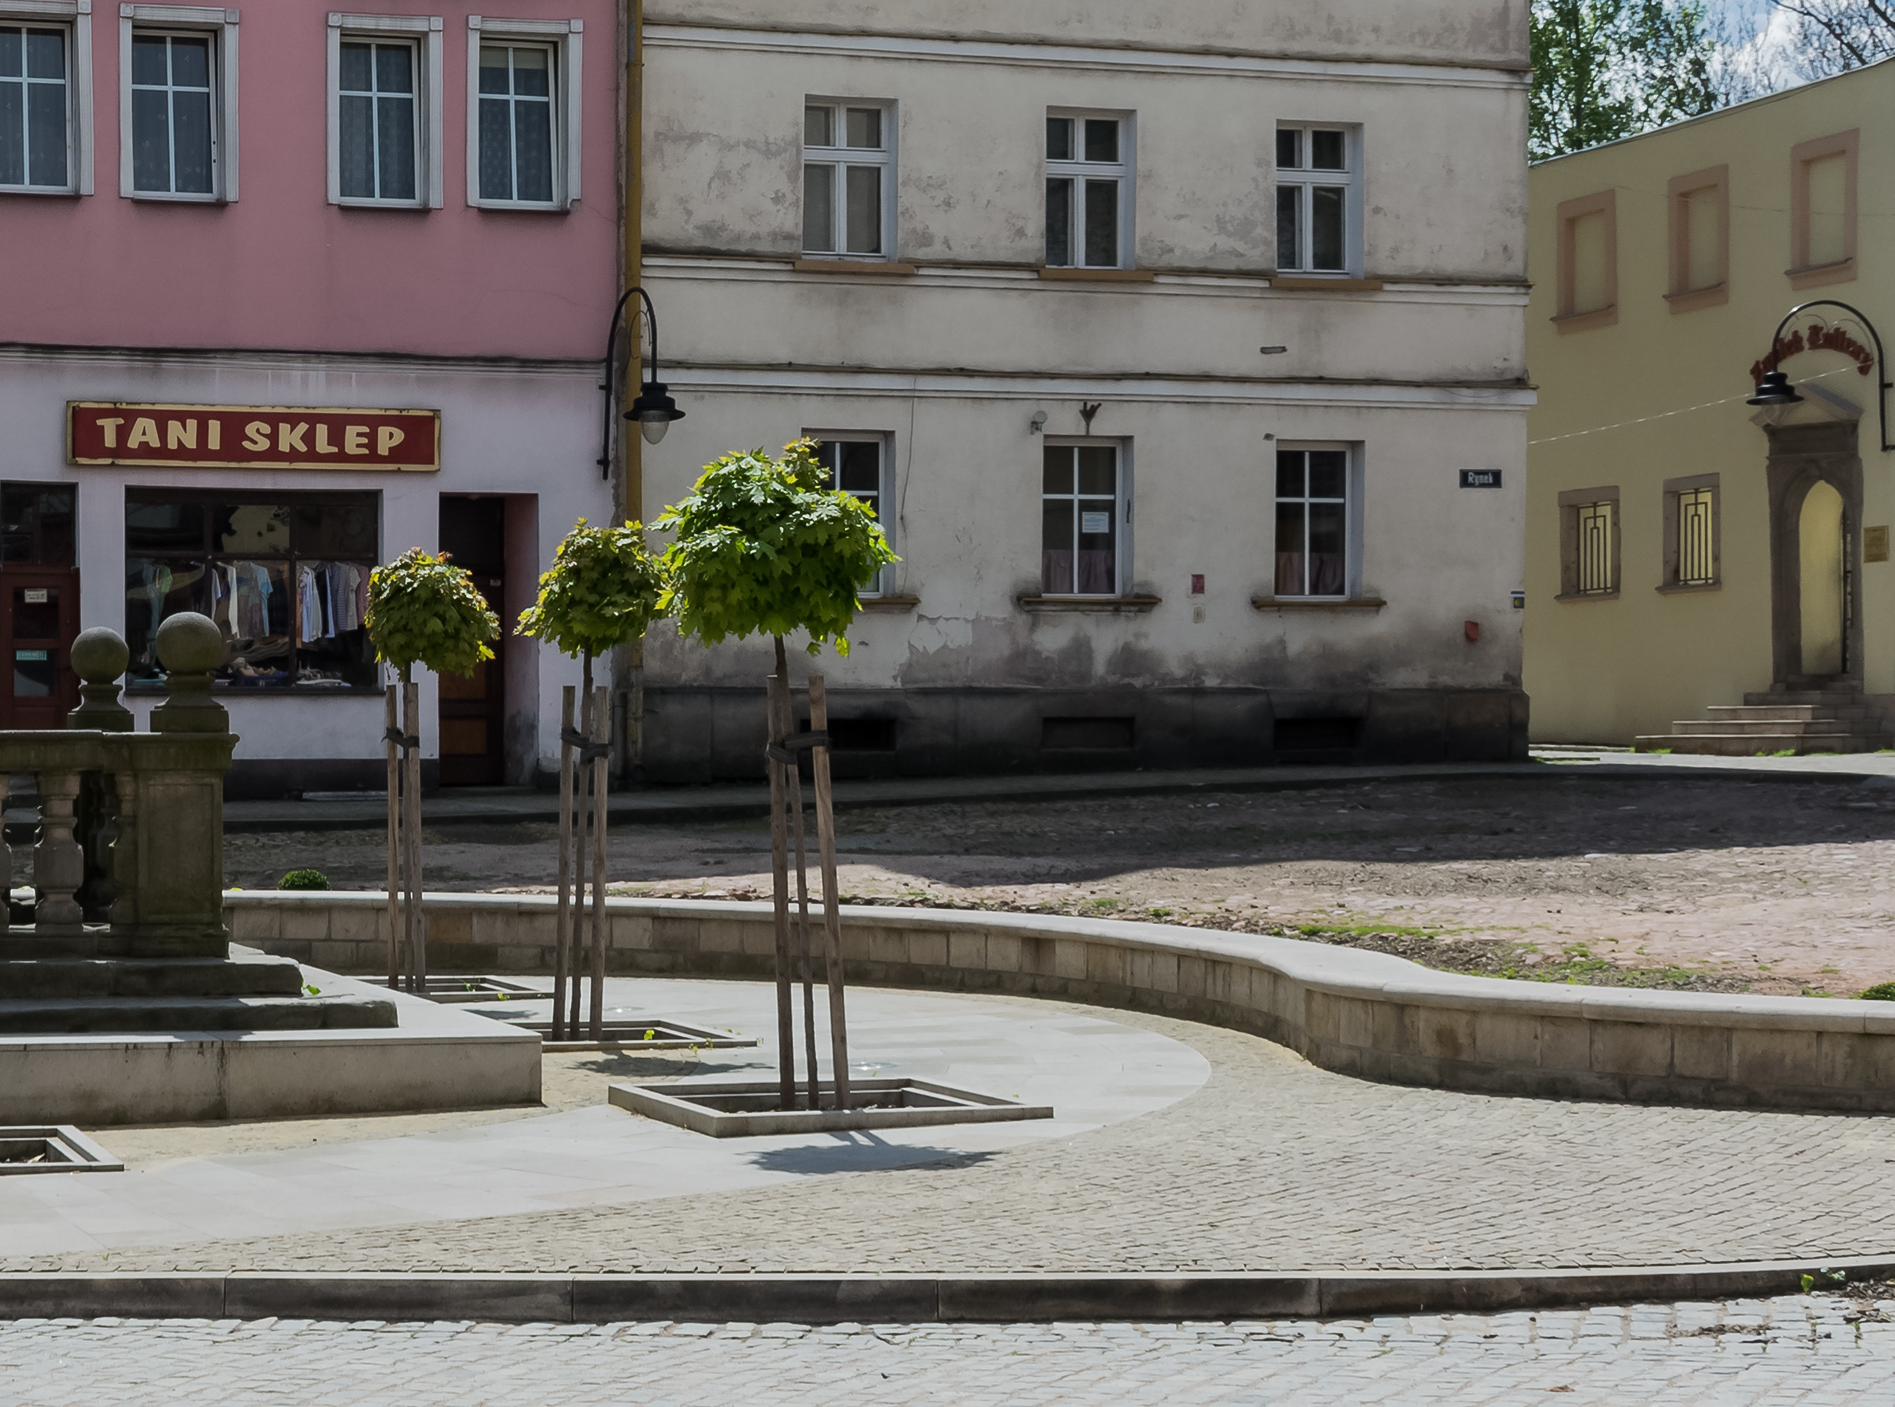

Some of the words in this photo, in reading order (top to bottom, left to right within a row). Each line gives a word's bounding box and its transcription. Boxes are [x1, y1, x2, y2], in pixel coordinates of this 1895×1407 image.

[96, 417, 221, 450] TANI
[241, 420, 405, 456] SKLEP
[1467, 471, 1494, 486] Rynek
